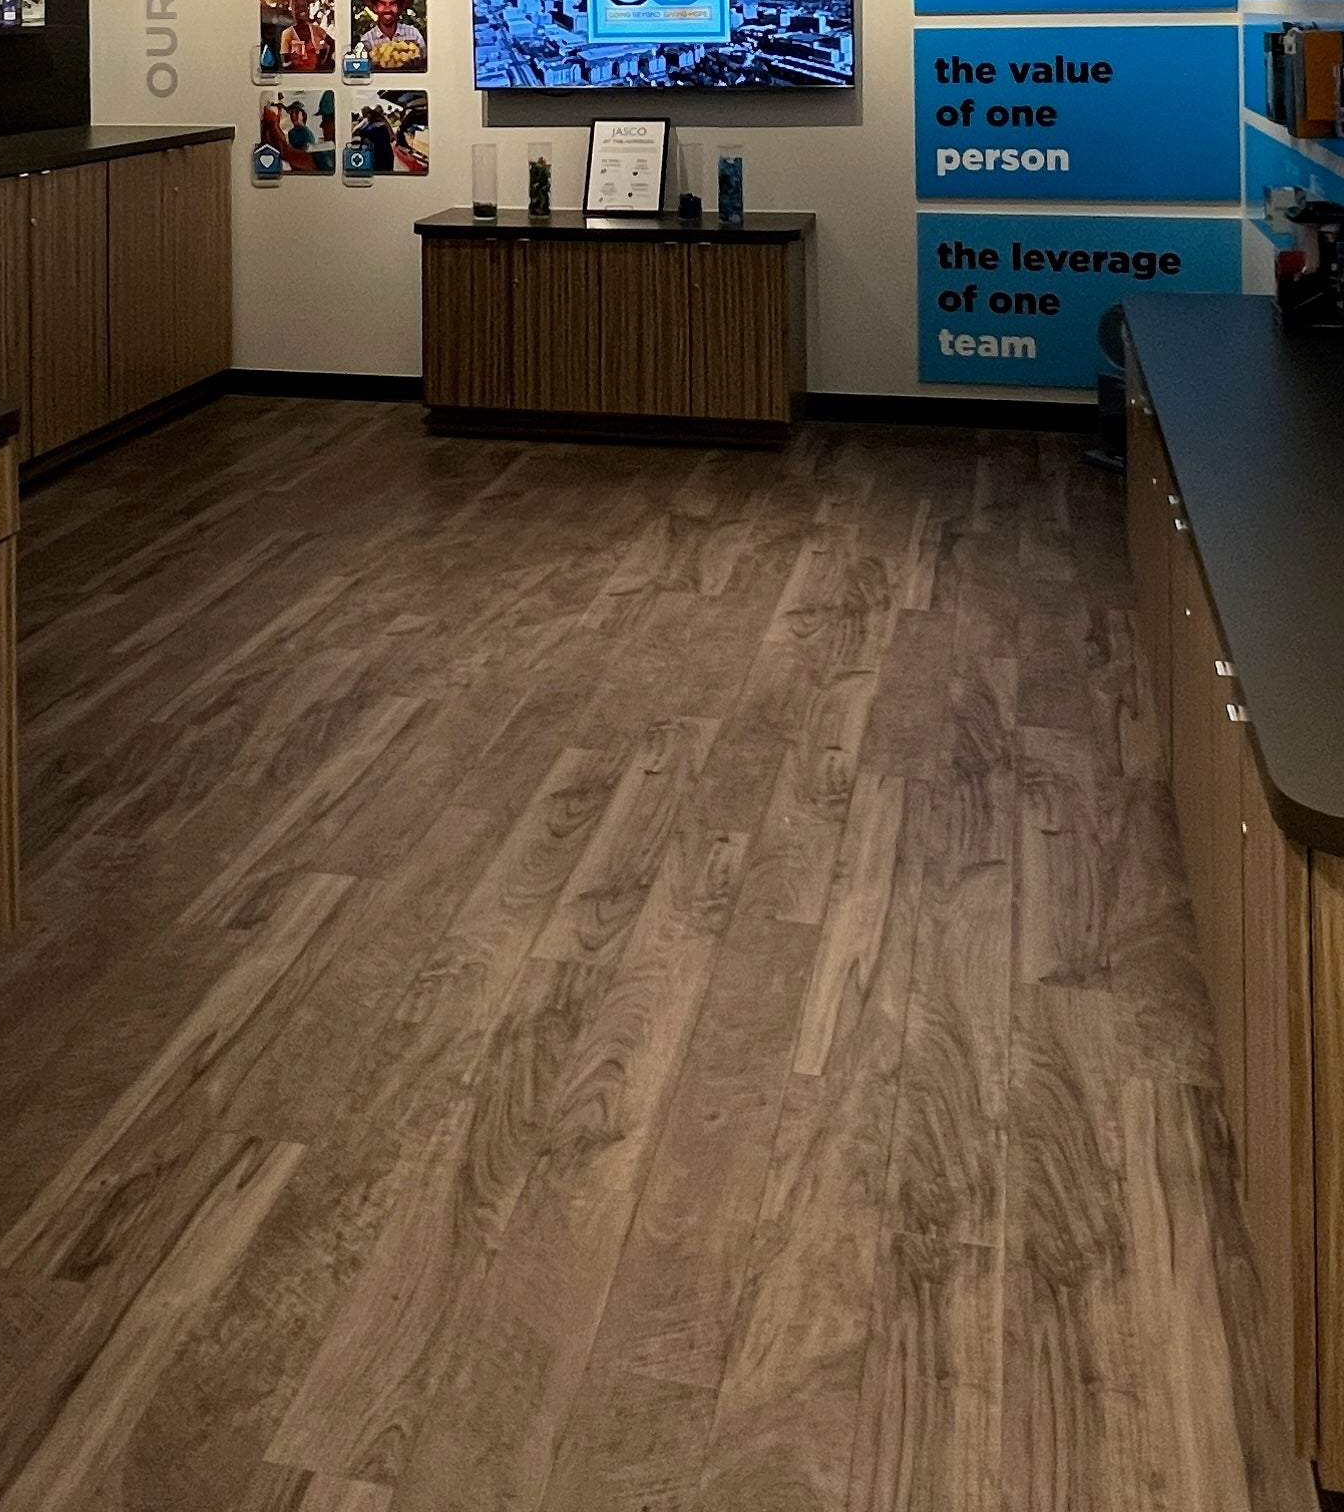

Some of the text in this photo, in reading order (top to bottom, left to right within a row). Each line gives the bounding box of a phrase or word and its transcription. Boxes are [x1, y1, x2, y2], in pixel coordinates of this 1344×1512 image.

[934, 54, 1114, 84] the value
[935, 99, 1057, 129] of one
[612, 126, 647, 136] JASCO
[936, 143, 1070, 178] person
[937, 240, 1182, 281] the leverage
[937, 283, 1061, 316] of one
[937, 327, 1037, 360] team
